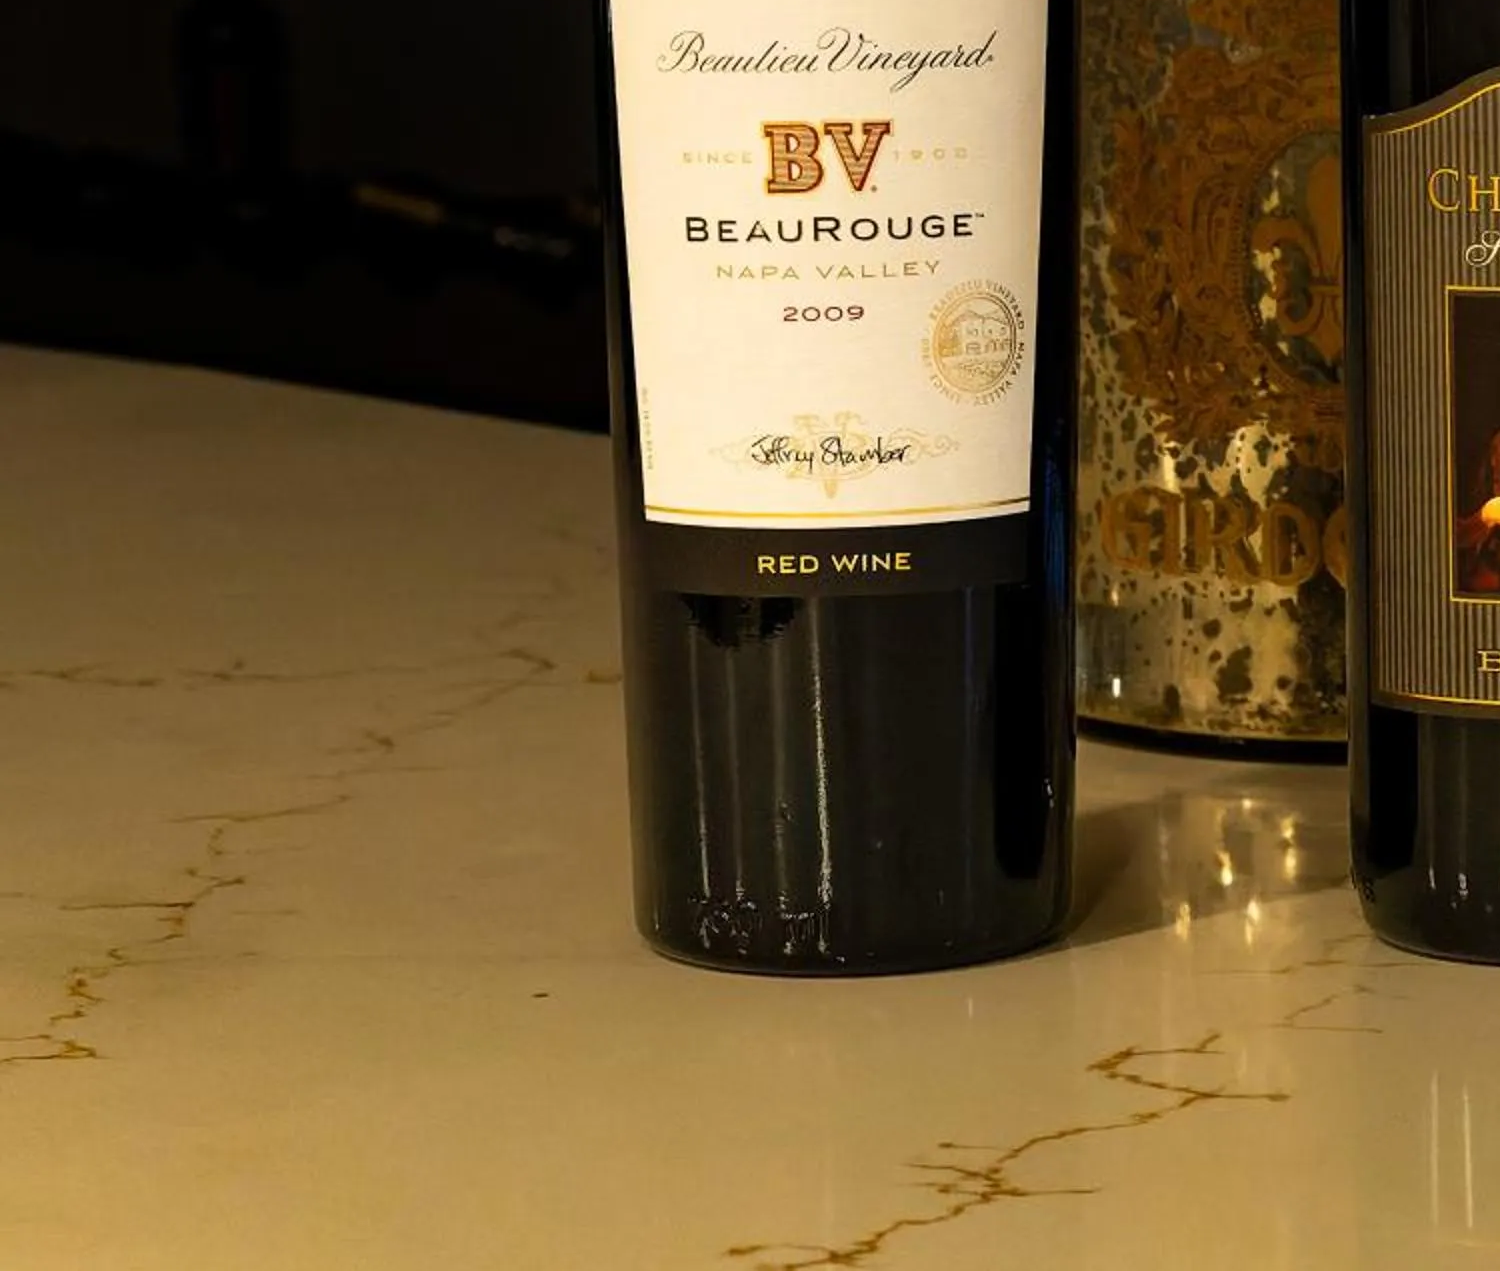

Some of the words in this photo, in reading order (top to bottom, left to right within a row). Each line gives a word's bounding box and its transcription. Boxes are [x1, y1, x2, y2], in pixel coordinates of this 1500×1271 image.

[657, 30, 820, 74] Beaulieu
[816, 26, 998, 93] Vineyard
[682, 151, 753, 164] SINCE
[760, 119, 893, 195] BV
[716, 263, 800, 281] NAPA
[815, 260, 942, 279] VALLEY
[782, 305, 867, 323] 2009
[757, 553, 820, 574] RED
[831, 551, 912, 572] WINE
